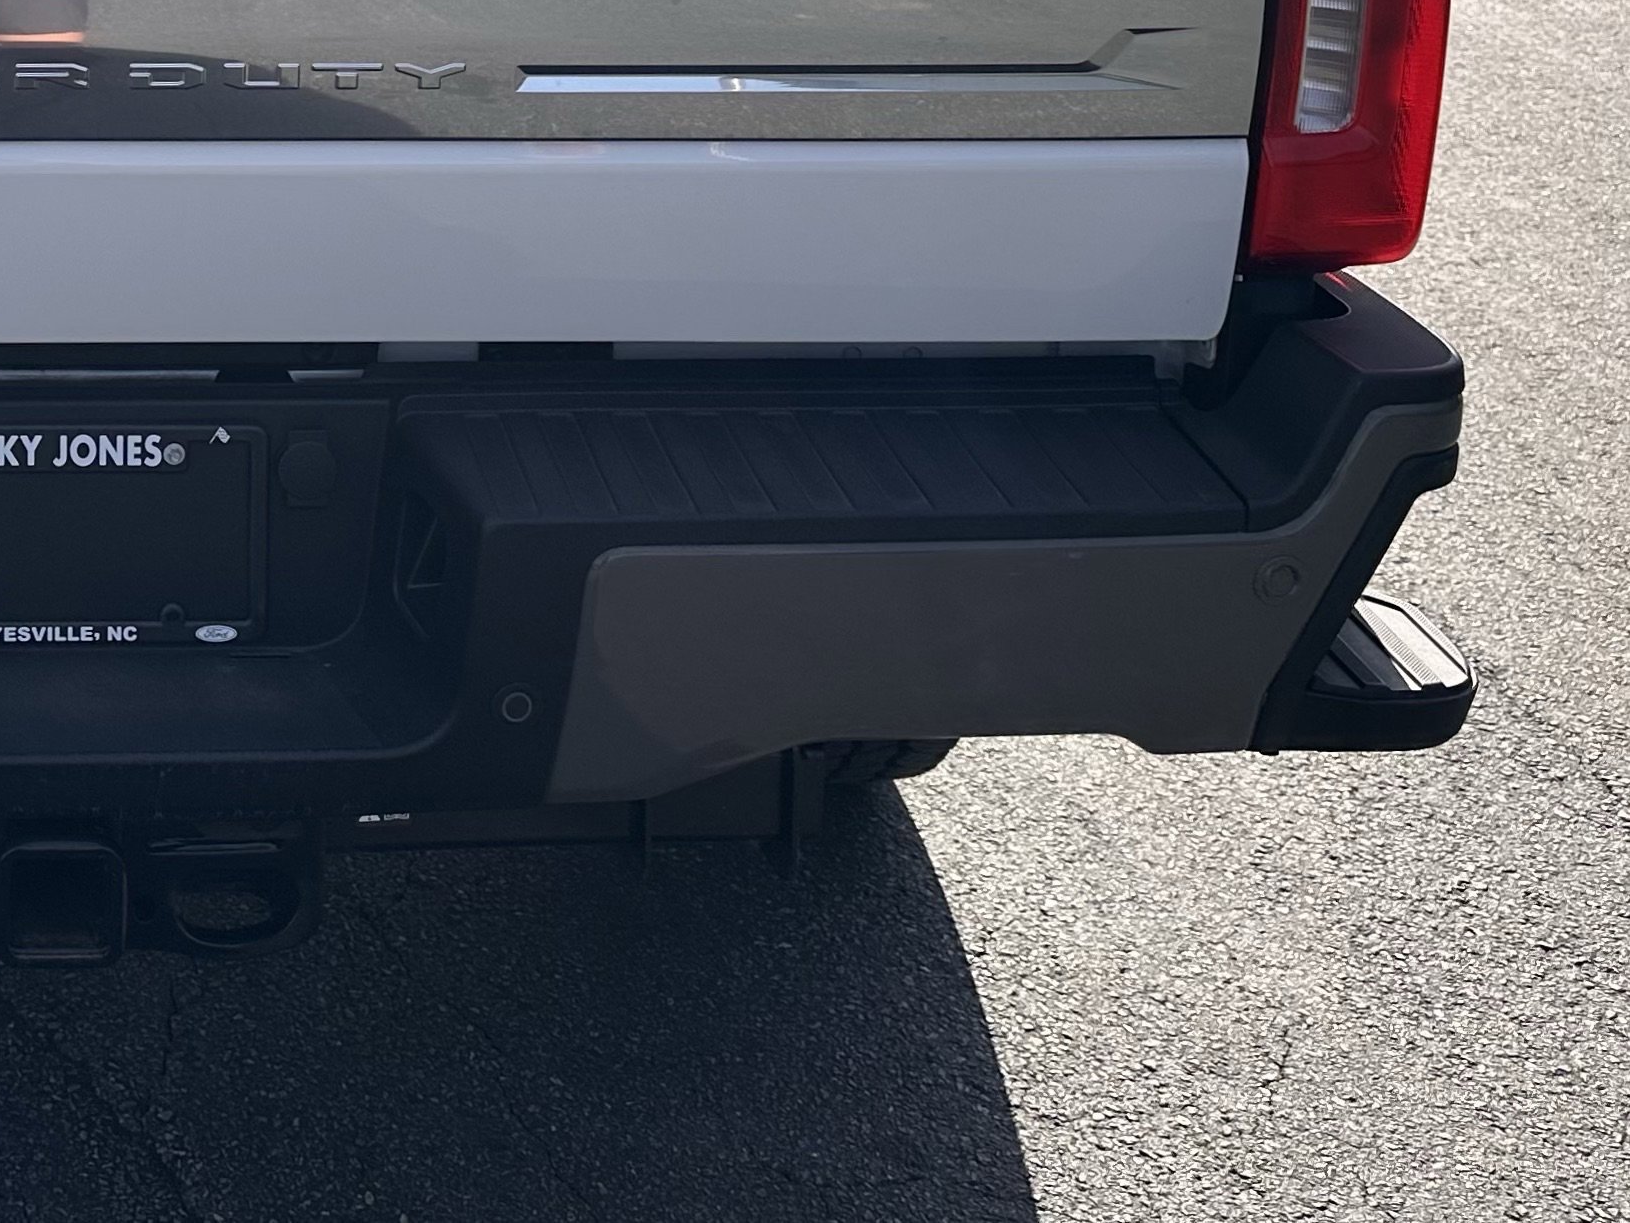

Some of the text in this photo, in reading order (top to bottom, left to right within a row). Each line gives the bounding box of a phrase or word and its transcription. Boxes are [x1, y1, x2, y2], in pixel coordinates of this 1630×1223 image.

[128, 62, 467, 90] DUTY
[52, 434, 162, 467] JONES
[108, 626, 138, 642] NC
